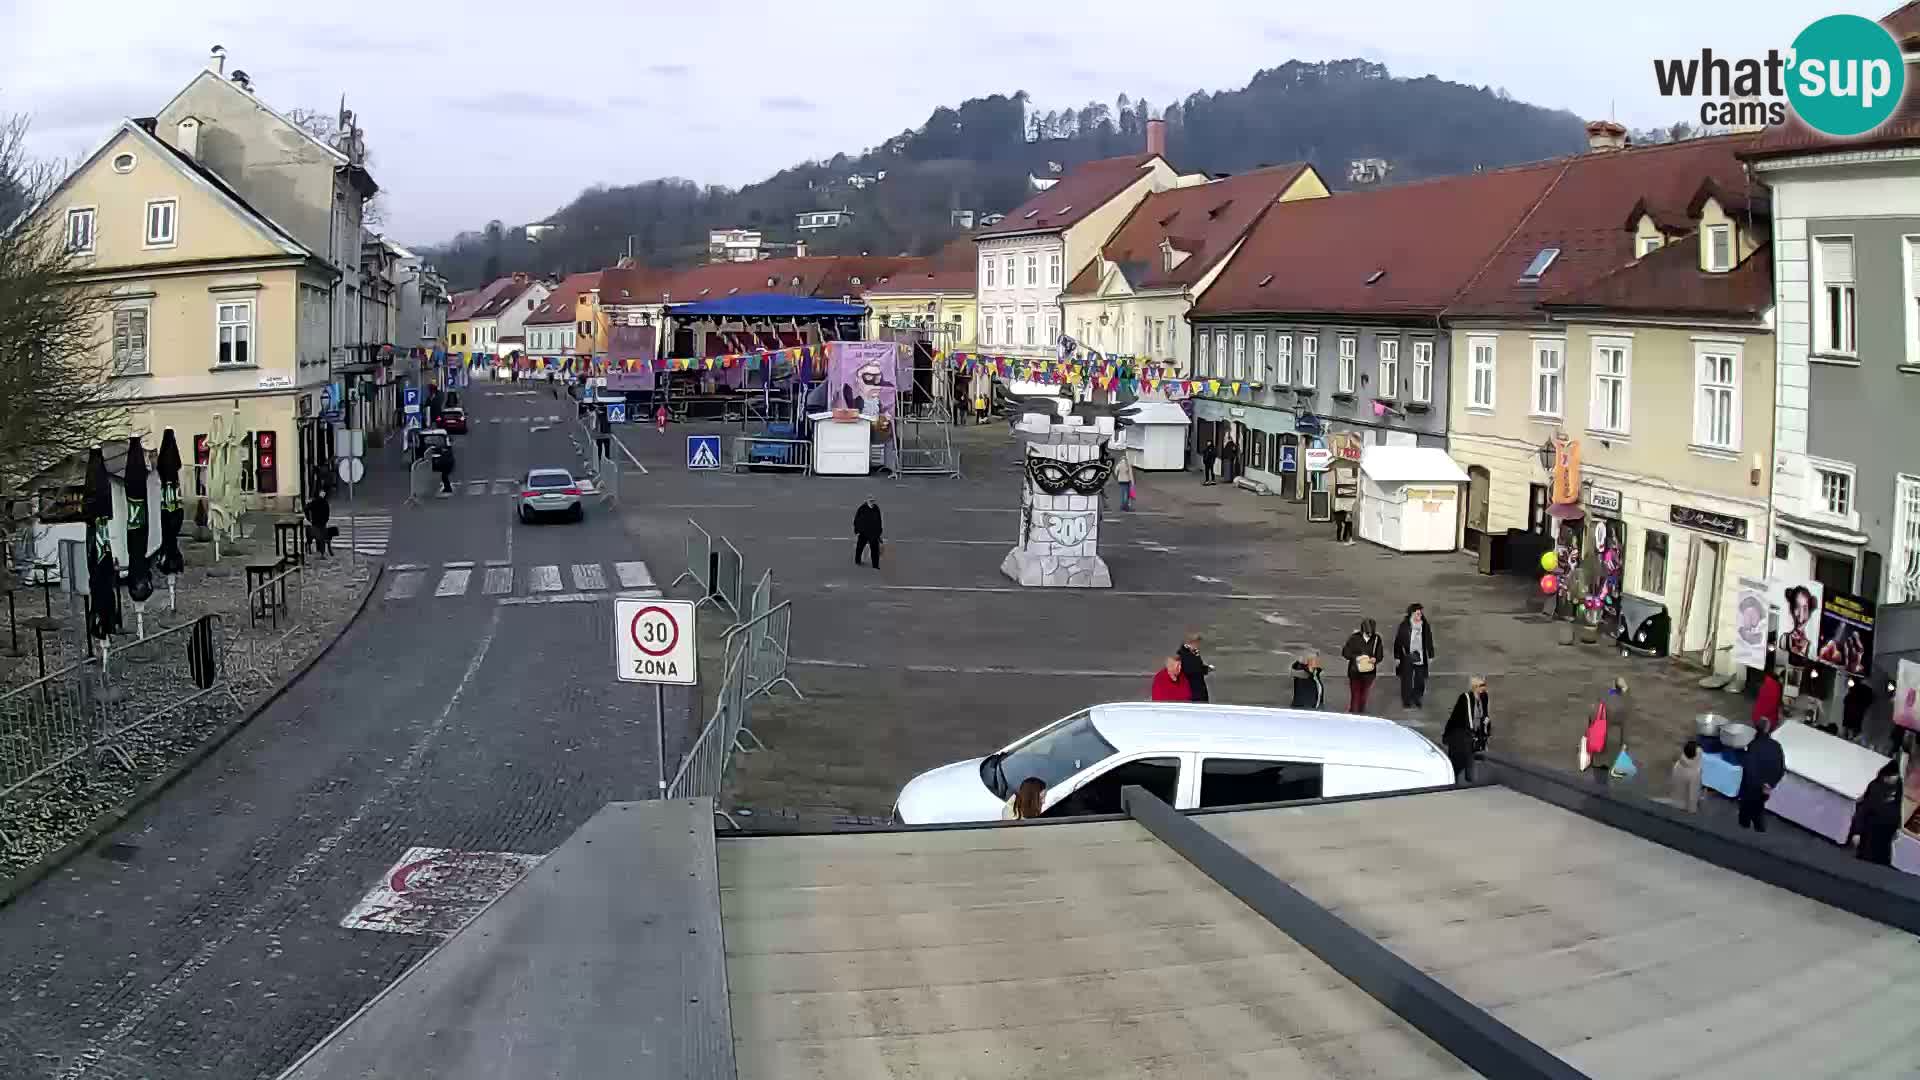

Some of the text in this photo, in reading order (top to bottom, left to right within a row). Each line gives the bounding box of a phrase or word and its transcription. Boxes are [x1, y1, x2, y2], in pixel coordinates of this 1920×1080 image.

[1048, 516, 1087, 546] 200
[643, 622, 667, 642] 30
[633, 659, 678, 676] ZONA
